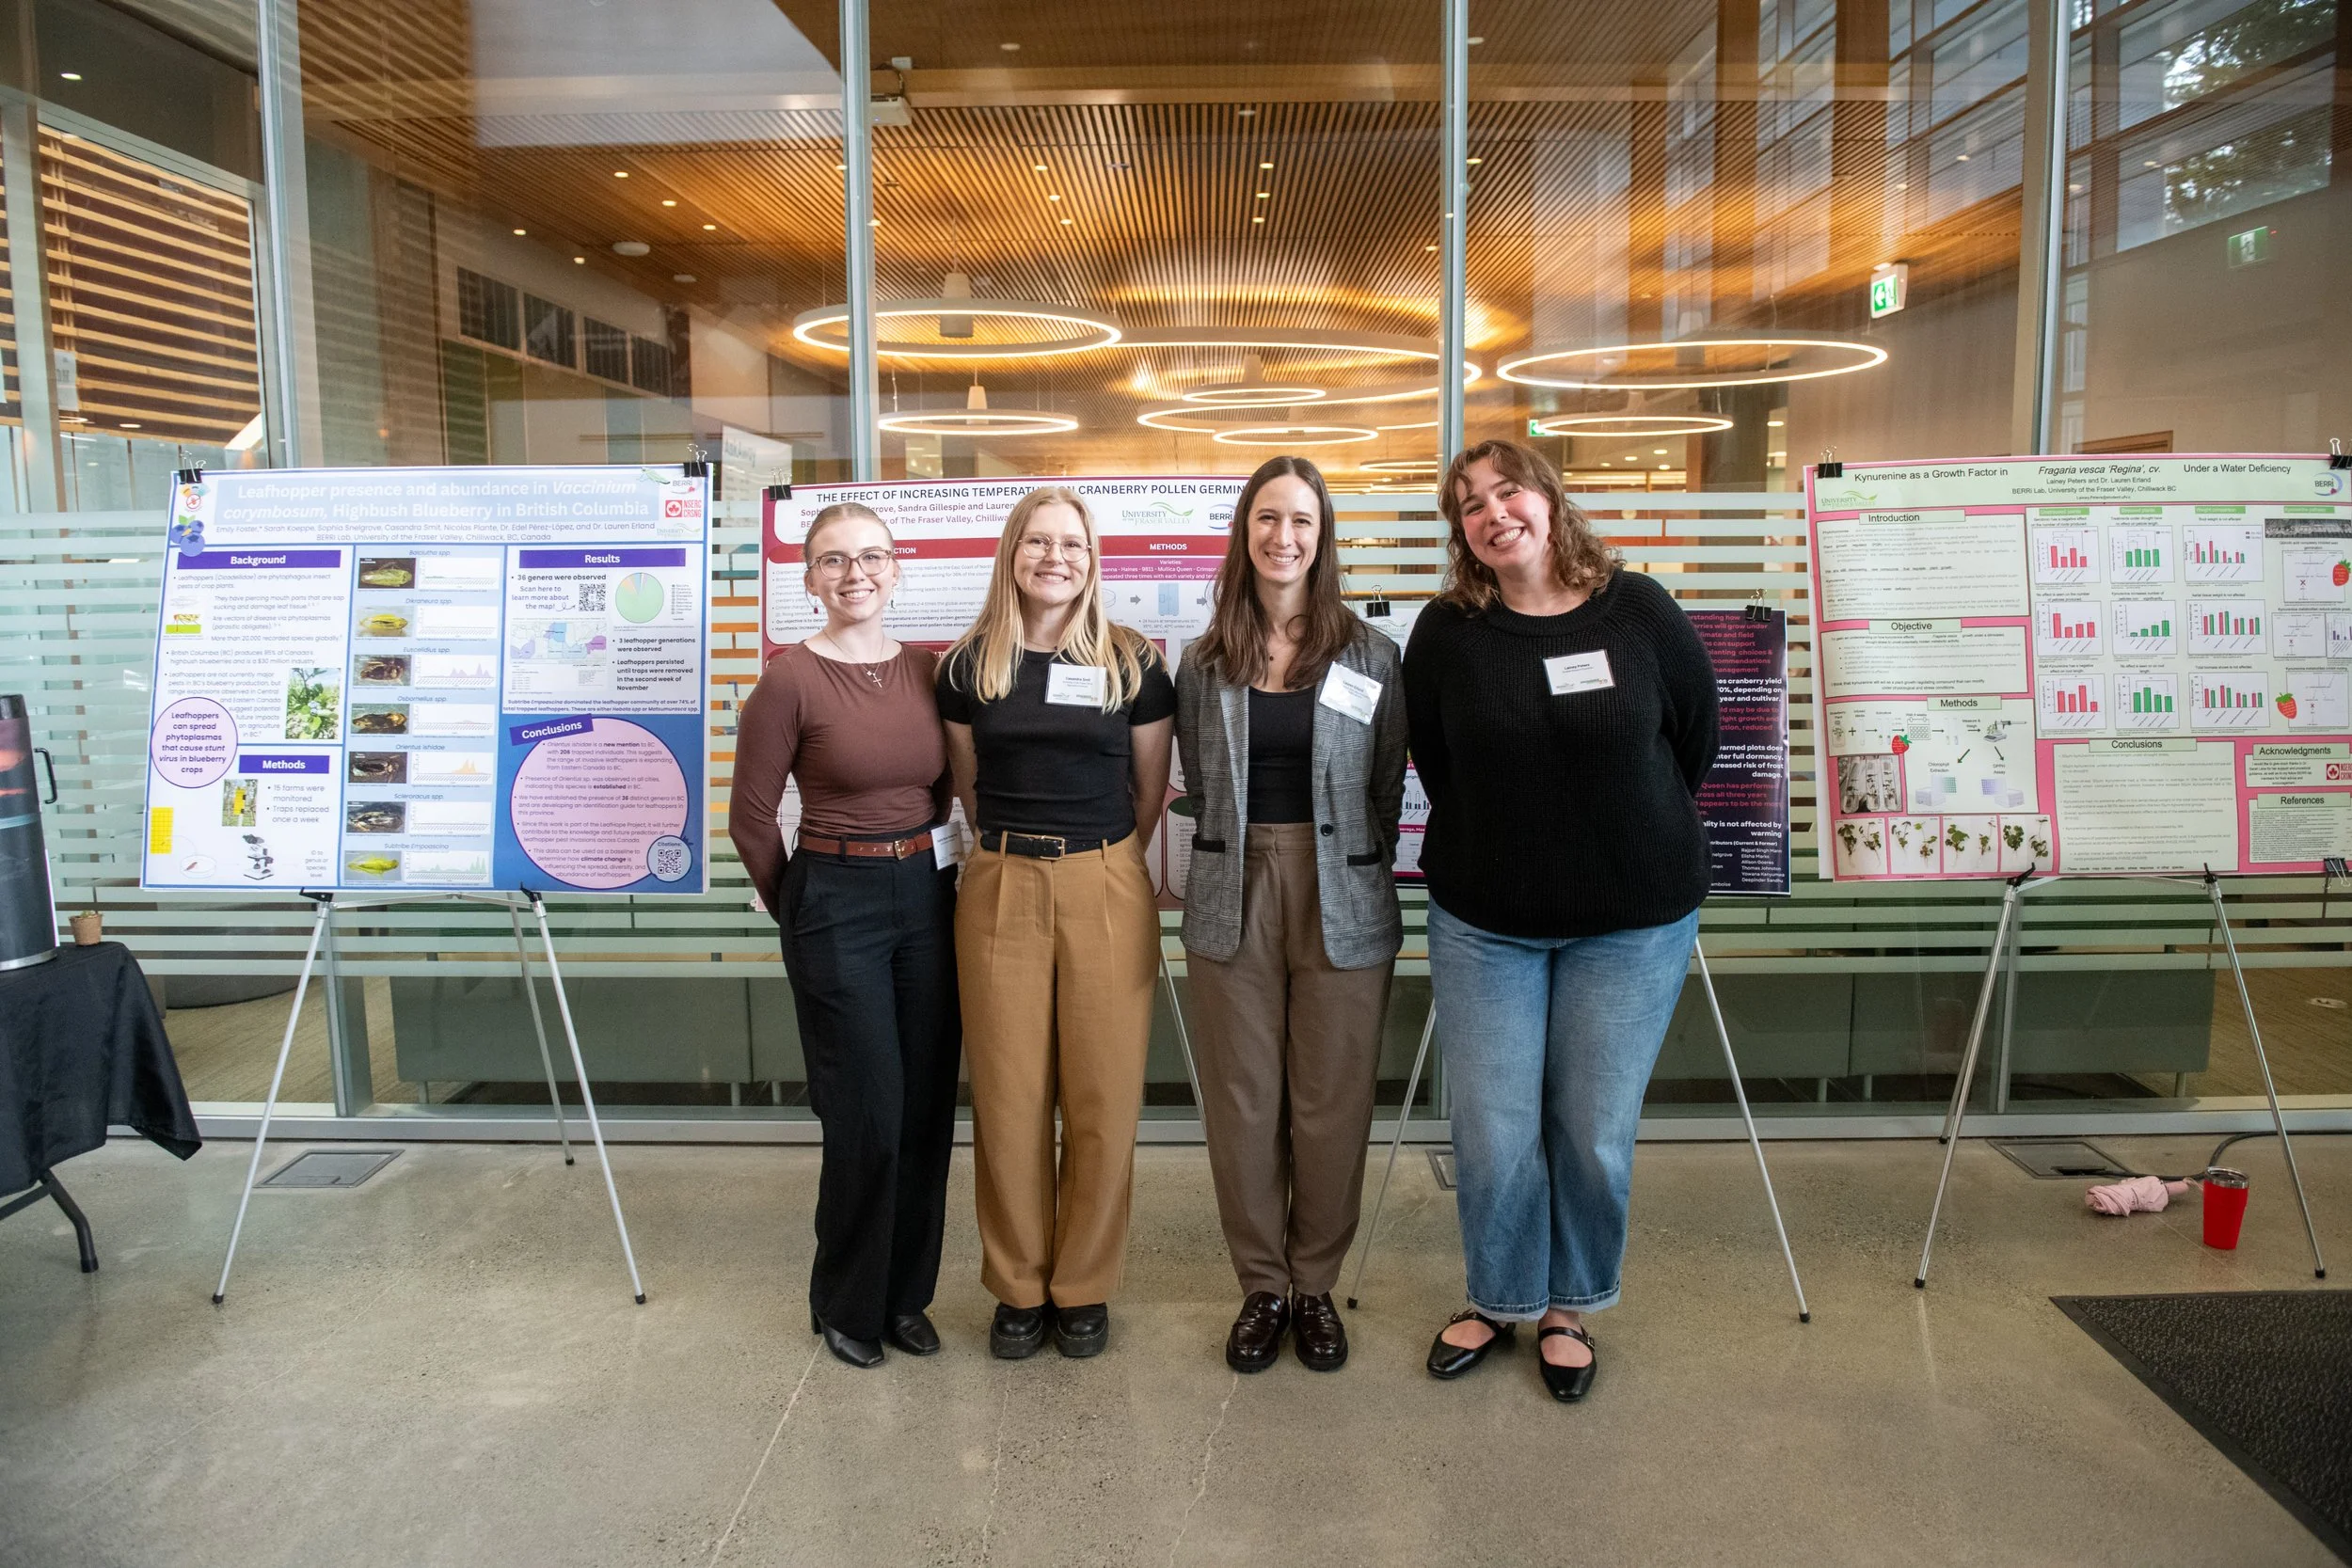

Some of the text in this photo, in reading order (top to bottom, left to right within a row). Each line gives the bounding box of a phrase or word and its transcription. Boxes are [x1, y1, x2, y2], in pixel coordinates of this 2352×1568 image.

[2038, 466, 2076, 476] Fragaria
[2249, 464, 2291, 474] Deficiency
[1854, 473, 1907, 483] Kynurenine
[1968, 468, 1996, 477] Factor
[2314, 478, 2334, 487] BERRi
[238, 481, 636, 500] Leafhopper presence and abundance in Vaccinium
[817, 493, 837, 502] THE
[840, 492, 879, 501] EFFECT
[882, 490, 897, 499] OF
[900, 487, 969, 499] INCREASING
[1078, 484, 1148, 495] CRANBERRY
[1152, 484, 1196, 494] POLLEN
[1200, 484, 1245, 494] GERMIN
[224, 501, 649, 523] corymbosum, Highbush Blueberry in British Columbia
[930, 503, 965, 513] Gillespie
[968, 502, 984, 511] and
[890, 516, 898, 525] of
[946, 515, 974, 524] Valley,
[1209, 511, 1232, 520] BERRi
[230, 555, 286, 566] Background
[585, 554, 620, 563] Results
[1891, 622, 1932, 631] Objective
[1940, 699, 1978, 707] Methods
[171, 712, 219, 721] Leafhoppers
[190, 723, 216, 732] spread
[522, 721, 582, 739] Conclusions
[166, 734, 222, 742] phytoplasmas
[2111, 740, 2162, 749] Conclusions
[2259, 747, 2331, 756] Acknowledgments
[189, 755, 227, 764] blueberry
[262, 760, 306, 769] Methods
